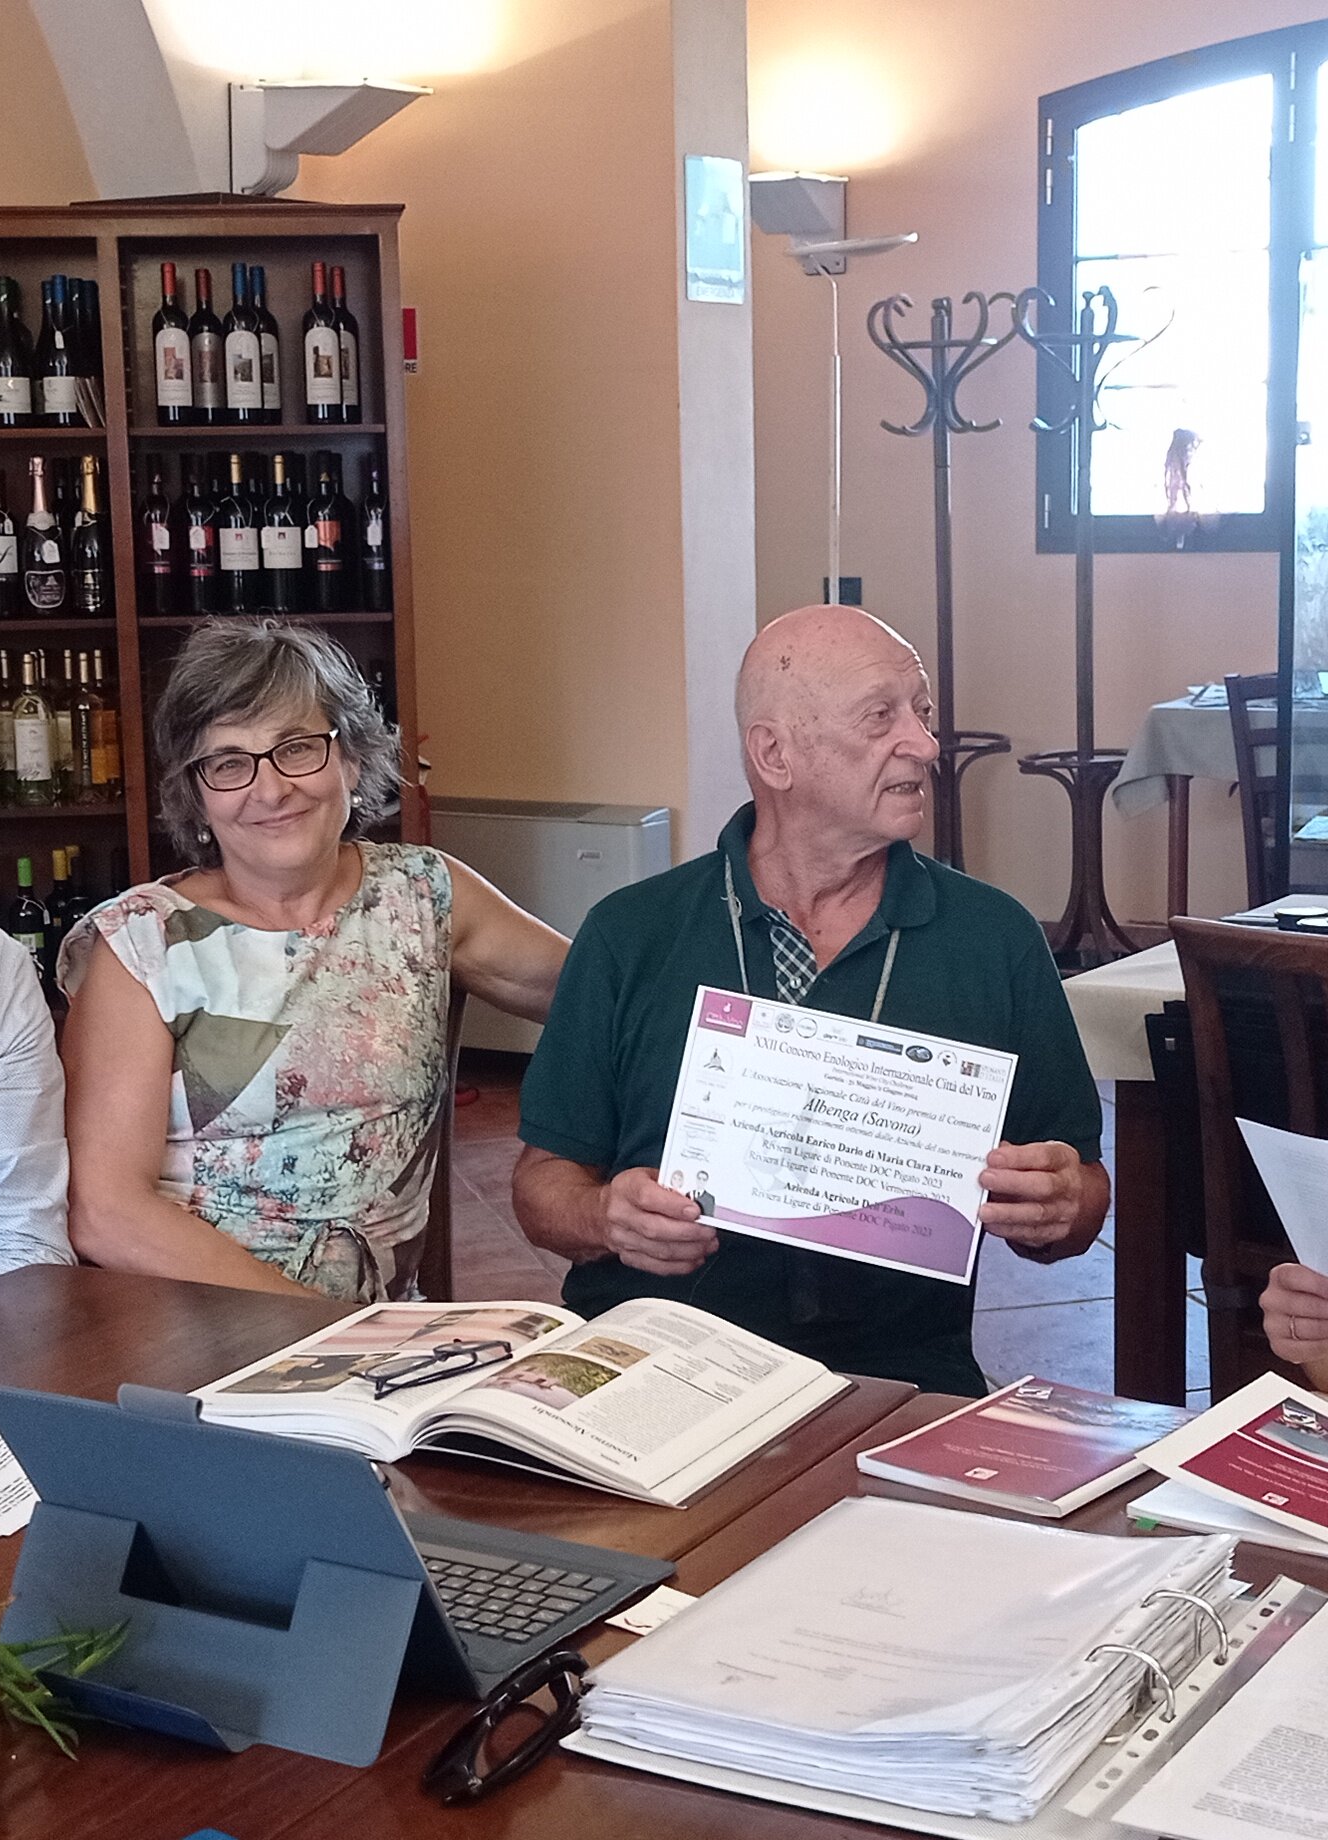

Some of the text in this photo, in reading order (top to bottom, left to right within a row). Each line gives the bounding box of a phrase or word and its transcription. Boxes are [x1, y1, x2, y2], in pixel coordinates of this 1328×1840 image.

[753, 1035, 998, 1101] XXII Concorso Enologico Internazionale Città del Vino
[802, 1095, 922, 1139] Albenga (Savona)
[805, 1082, 847, 1100] Nazionale
[848, 1092, 870, 1105] Città
[871, 1097, 885, 1109] del
[887, 1101, 905, 1113] Vino
[906, 1106, 937, 1123] premia
[938, 1113, 945, 1122] il
[946, 1115, 981, 1131] Comune
[982, 1122, 991, 1133] di
[729, 1117, 765, 1133] Azienda
[765, 1125, 804, 1144] Agricola
[805, 1135, 836, 1150] Enrico
[837, 1142, 863, 1156] Dario
[864, 1148, 875, 1158] di
[876, 1151, 904, 1166] Maria
[905, 1158, 932, 1172] Clara
[933, 1164, 964, 1179] Enrico
[761, 1139, 943, 1189] Riviera Ligure di Ponente DOC Pigato 2023
[779, 1157, 809, 1174] Ligure
[809, 1164, 819, 1175] di
[820, 1167, 854, 1183] Ponente
[855, 1174, 879, 1188] DOC
[879, 1180, 928, 1200] Vermentino
[783, 1180, 820, 1198] Azienda
[821, 1189, 860, 1207] Agricola
[751, 1187, 781, 1202] Riviera
[782, 1194, 811, 1211] Ligure
[811, 1201, 821, 1211] di
[822, 1203, 856, 1220] Ponente
[858, 1212, 880, 1225] DOC
[911, 1224, 933, 1238] 2023
